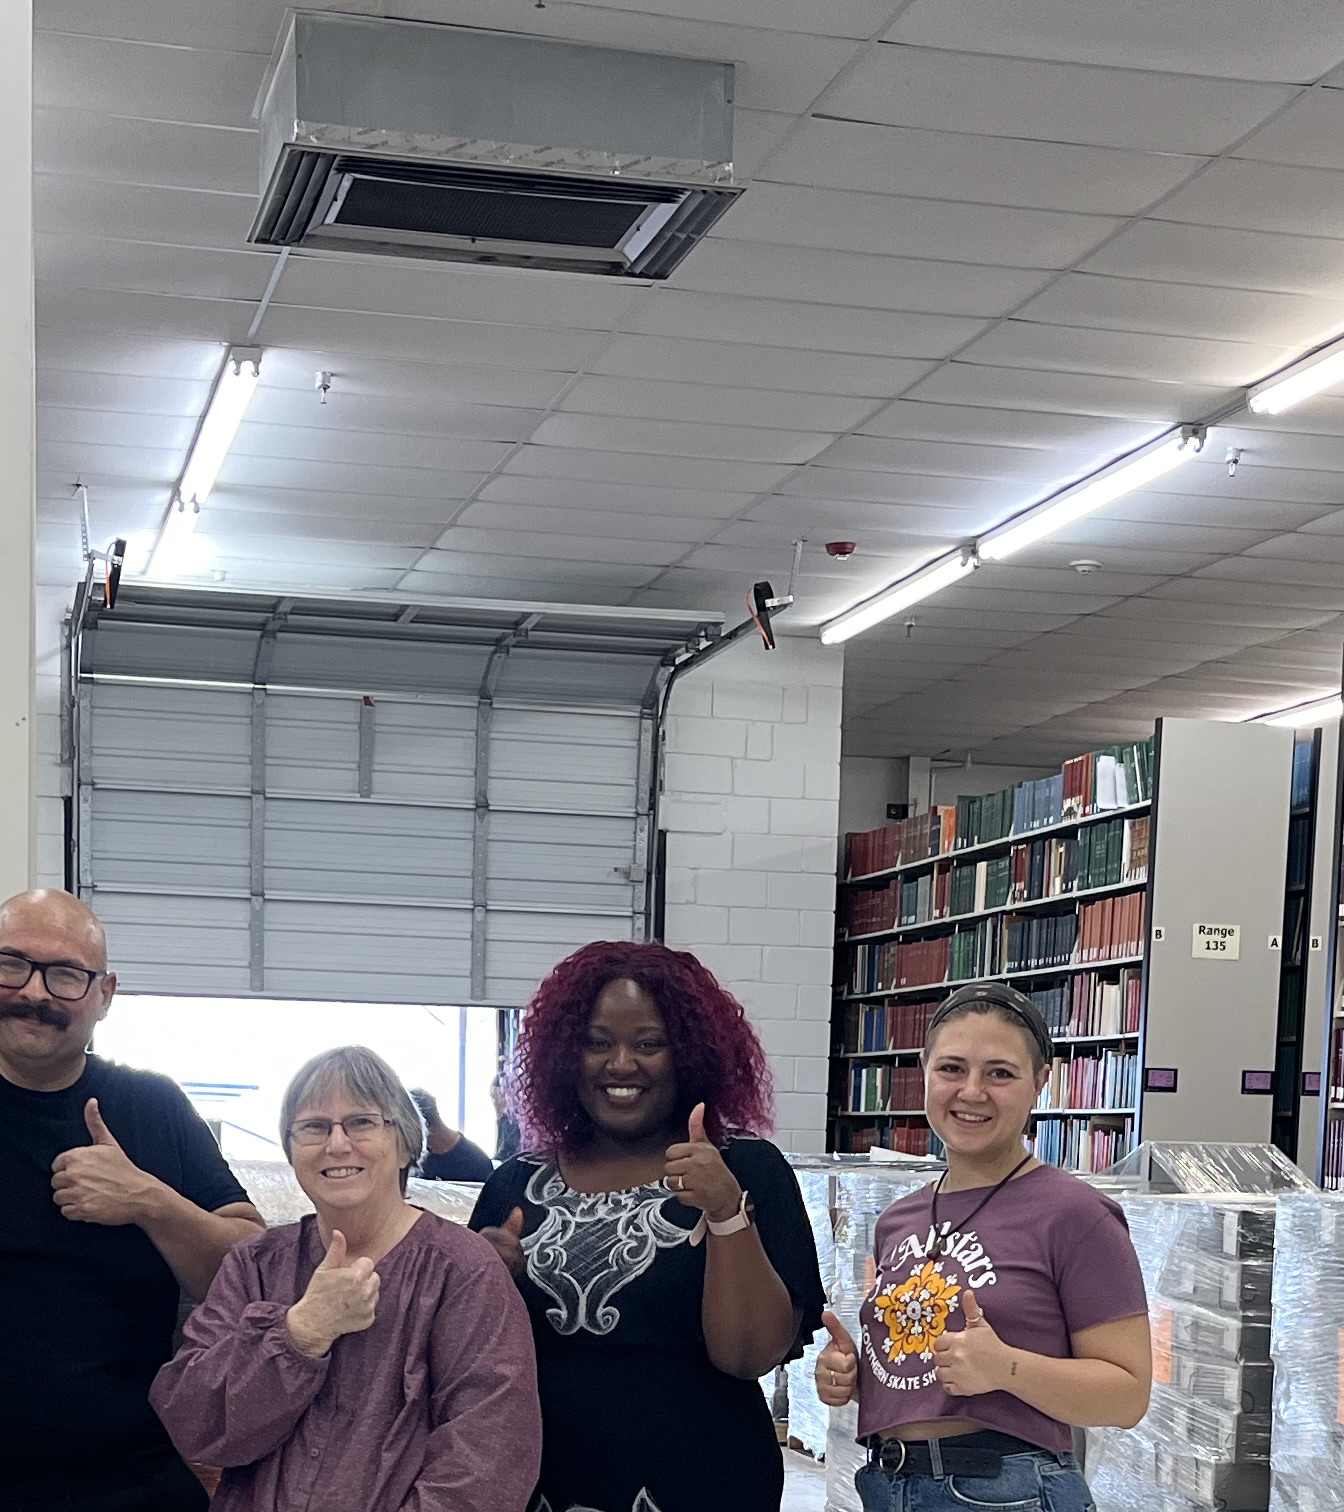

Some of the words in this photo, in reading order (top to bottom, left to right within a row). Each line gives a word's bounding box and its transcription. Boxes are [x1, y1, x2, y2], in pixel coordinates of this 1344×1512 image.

[1154, 929, 1163, 940] B
[1198, 924, 1236, 939] Range
[1204, 940, 1227, 952] 135
[1270, 938, 1279, 949] A
[1311, 938, 1320, 949] B
[861, 1323, 889, 1385] SOUTHERN
[887, 1372, 921, 1392] SKATE
